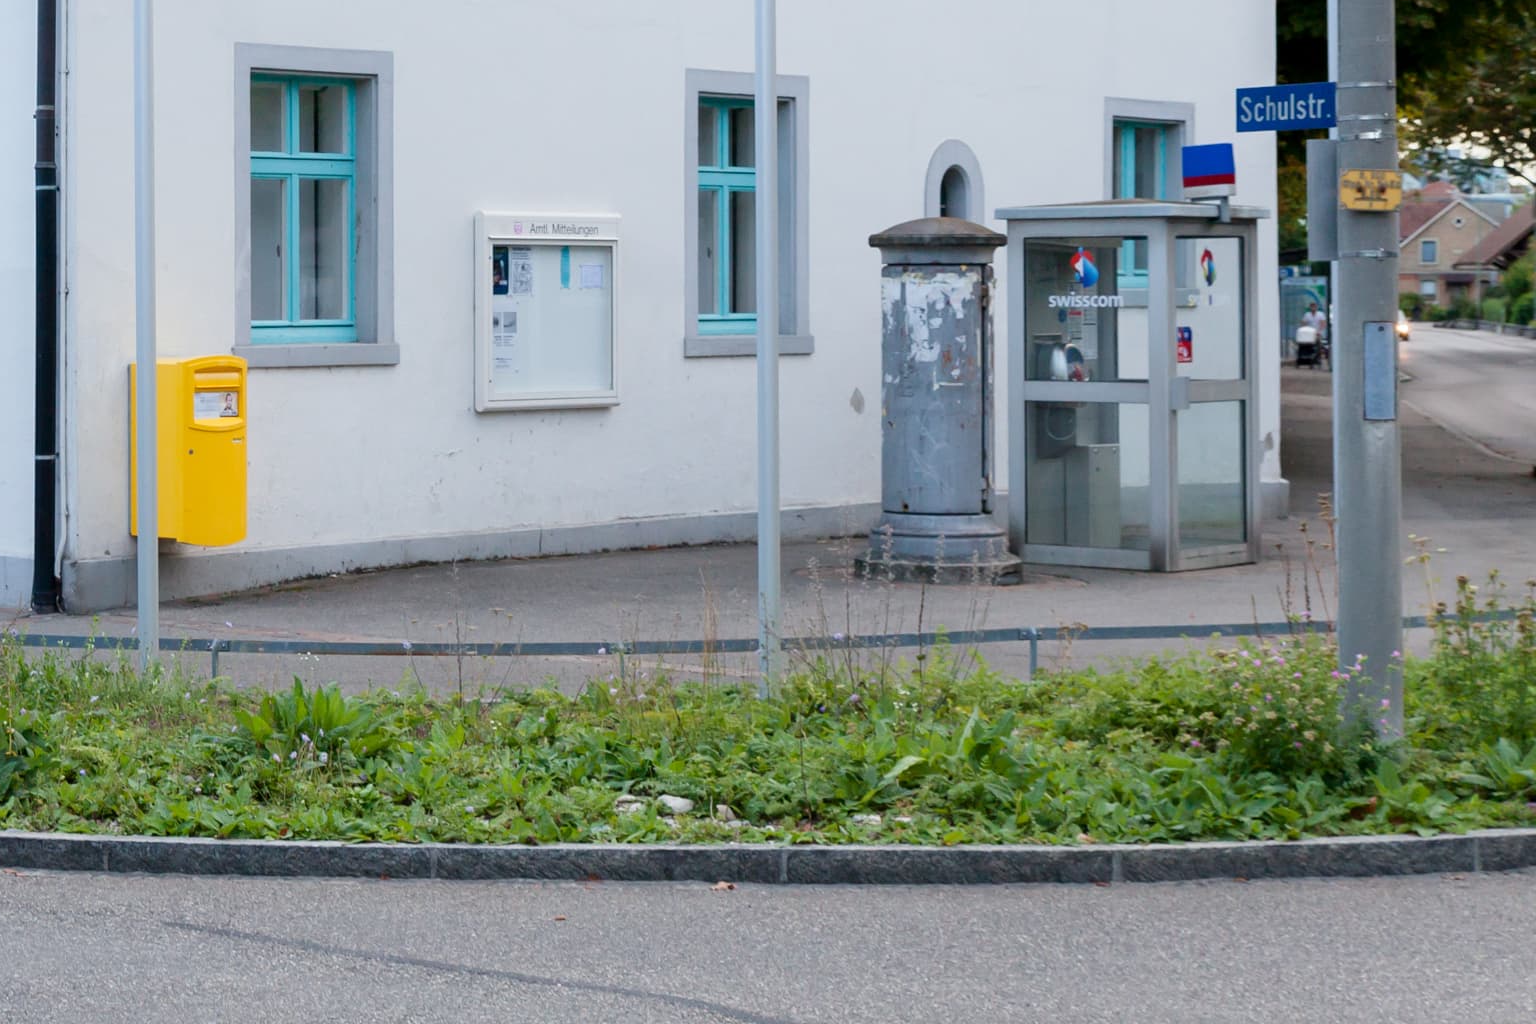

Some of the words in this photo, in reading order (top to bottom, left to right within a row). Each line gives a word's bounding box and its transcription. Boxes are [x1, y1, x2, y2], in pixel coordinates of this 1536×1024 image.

[1240, 93, 1332, 122] Schulstr.
[530, 223, 548, 234] Amtl.
[552, 223, 599, 236] Mitteilungen
[1048, 291, 1124, 308] swisscom
